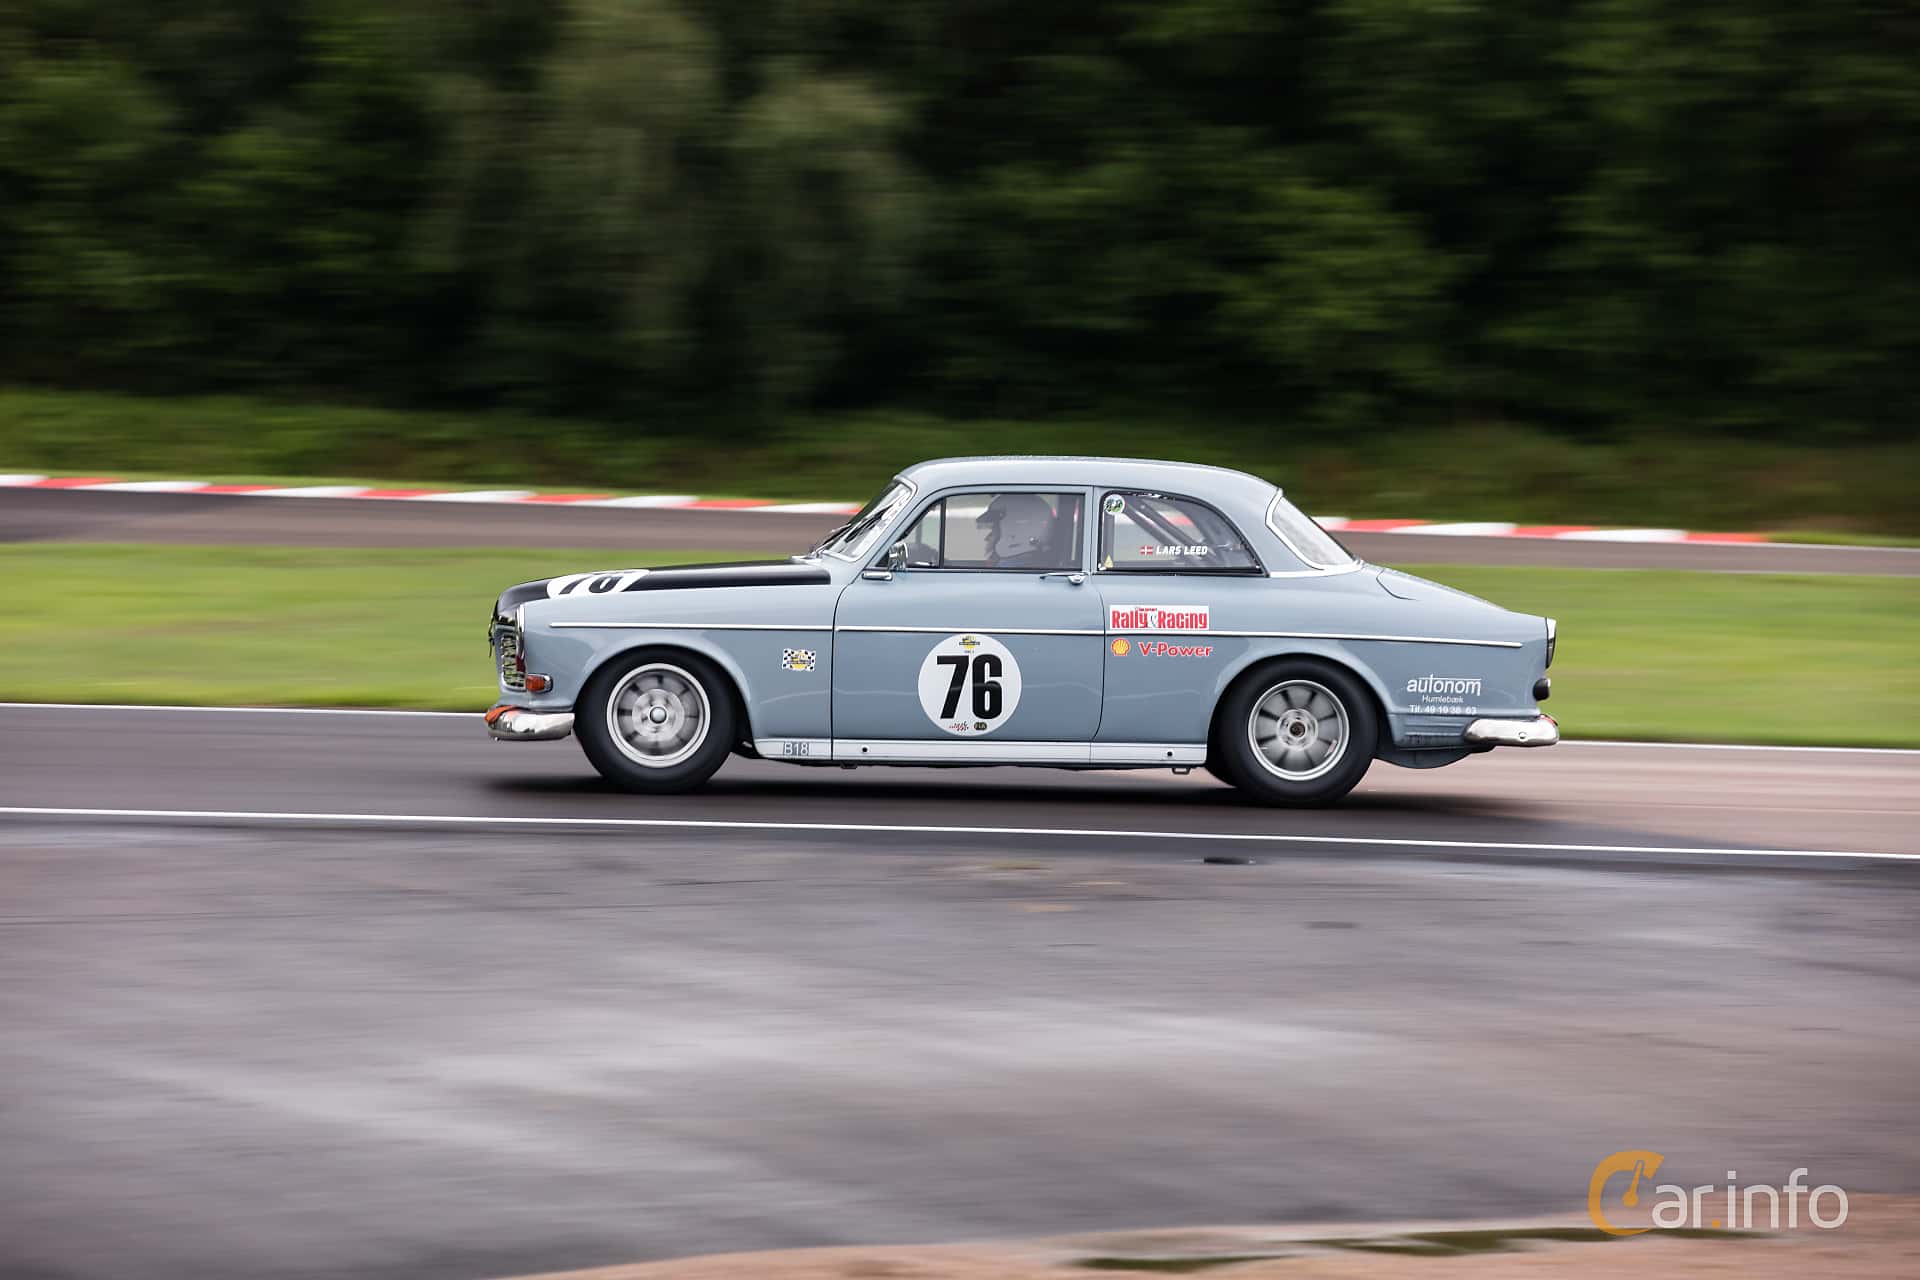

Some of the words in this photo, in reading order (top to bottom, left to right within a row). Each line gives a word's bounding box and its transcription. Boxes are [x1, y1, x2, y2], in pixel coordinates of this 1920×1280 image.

[1156, 546, 1181, 555] LARS
[1184, 546, 1208, 555] LEED
[1111, 610, 1148, 629] Rally
[1158, 610, 1208, 629] Racing
[1138, 641, 1213, 657] V-Power
[936, 654, 1002, 720] 76
[1406, 674, 1482, 696] autonom
[784, 742, 809, 755] B18
